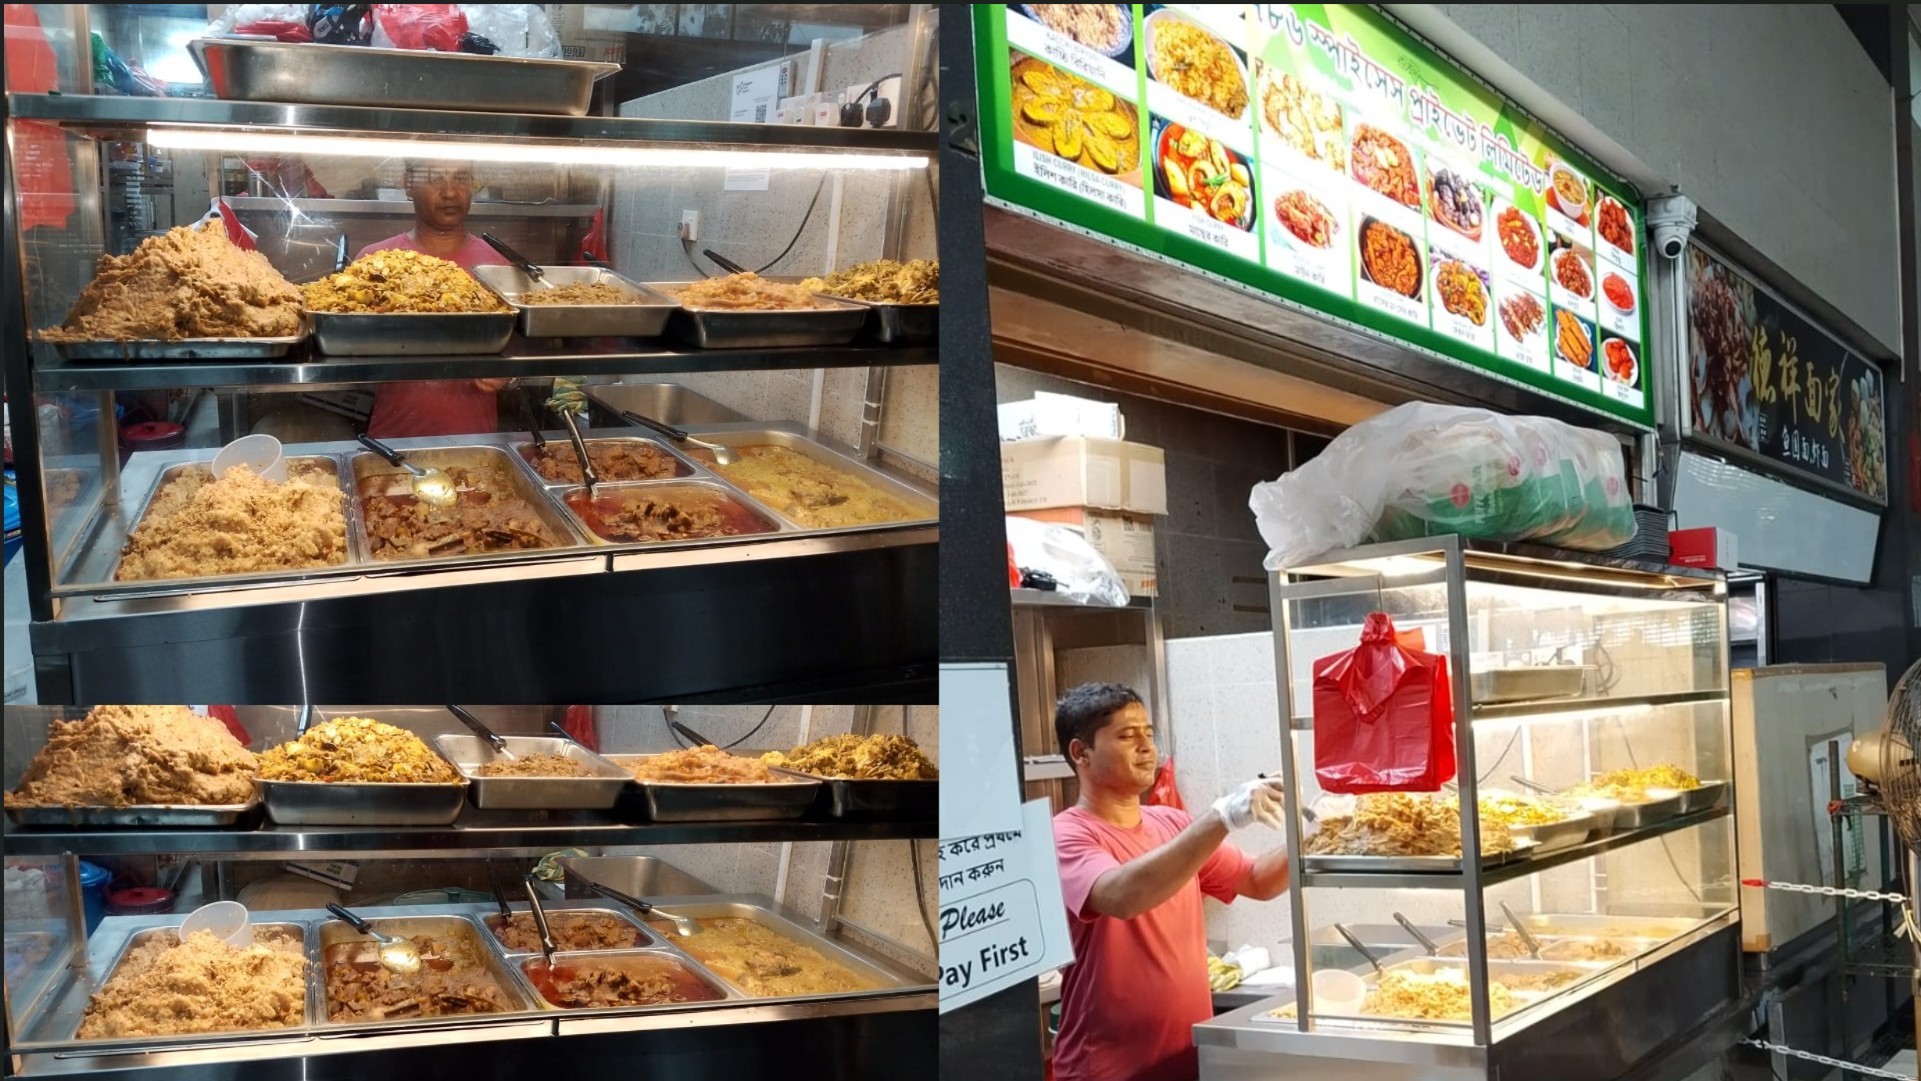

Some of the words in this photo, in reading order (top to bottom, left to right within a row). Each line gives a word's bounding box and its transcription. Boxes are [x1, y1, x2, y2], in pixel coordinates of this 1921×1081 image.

[1308, 23, 1405, 109] স্পাইসেস
[1410, 84, 1477, 153] প্রাইভেট
[1480, 129, 1545, 194] লিমিটেড
[1032, 150, 1052, 165] ILISH
[1053, 157, 1076, 174] CURRY
[1033, 161, 1057, 182] ইলিশ
[1058, 174, 1078, 190] কারি
[948, 836, 980, 856] করে
[966, 858, 1005, 881] করুন
[940, 901, 1006, 940] Please
[979, 936, 1029, 973] First
